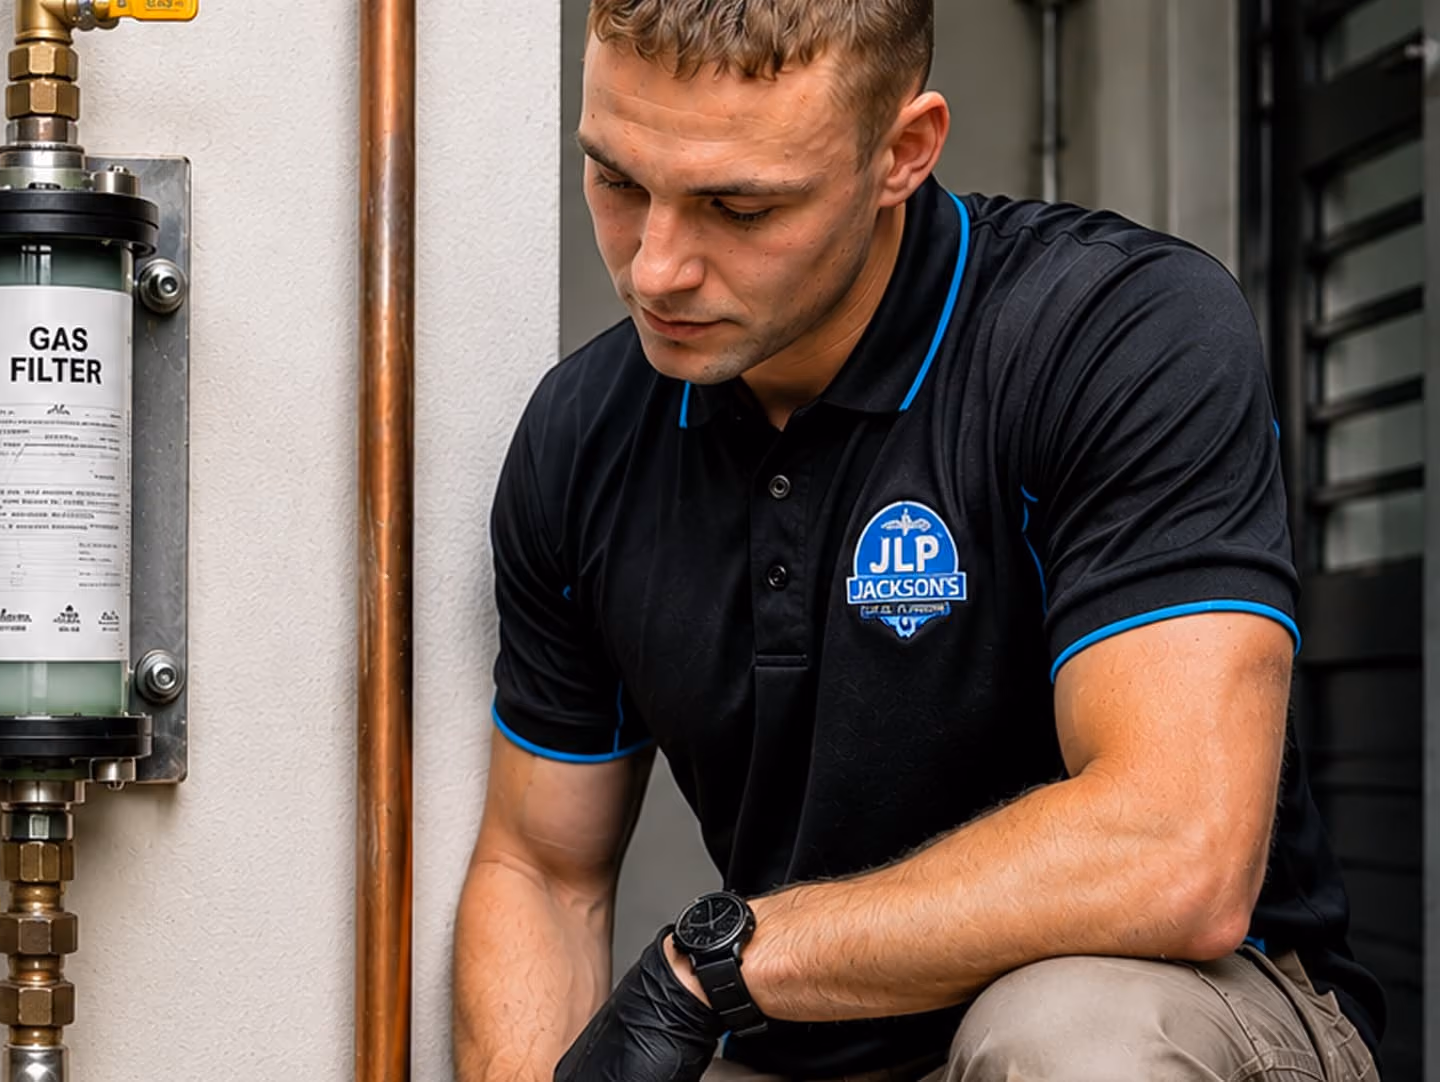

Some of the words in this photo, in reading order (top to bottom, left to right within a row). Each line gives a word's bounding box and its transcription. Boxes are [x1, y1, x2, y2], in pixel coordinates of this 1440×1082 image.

[29, 327, 88, 352] GAS
[11, 357, 102, 384] FILTER
[869, 534, 939, 573] JLP
[851, 577, 959, 600] JACKSON'S
